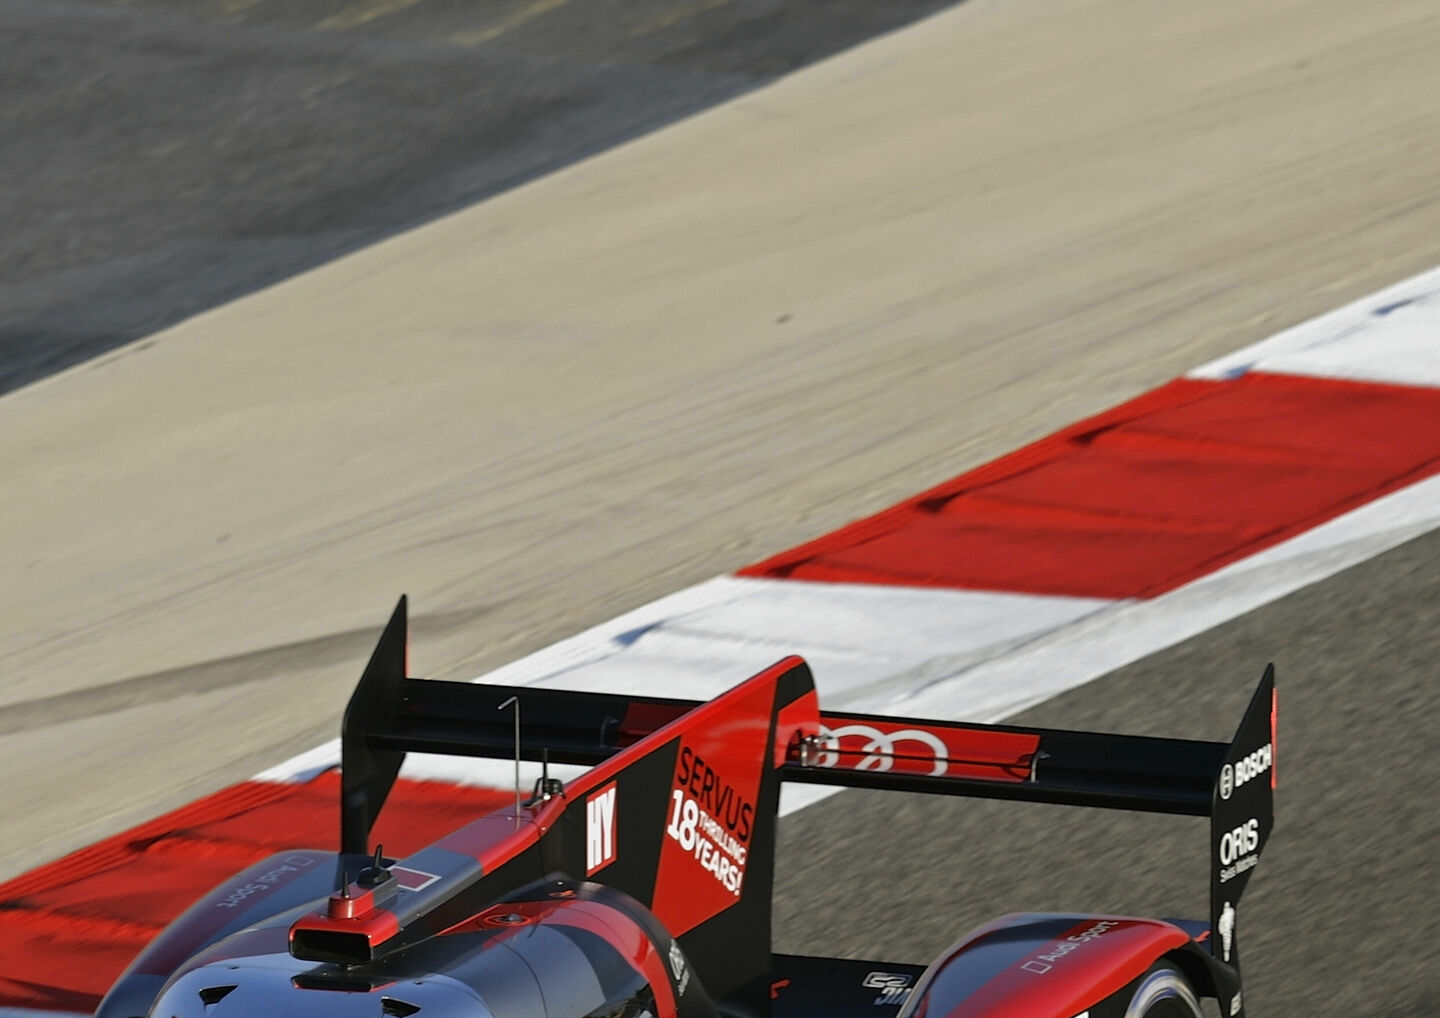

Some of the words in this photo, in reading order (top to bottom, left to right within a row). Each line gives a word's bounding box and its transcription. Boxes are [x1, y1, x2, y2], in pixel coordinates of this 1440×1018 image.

[677, 746, 753, 842] SERVUS
[1234, 743, 1271, 787] BOSCH
[587, 787, 616, 871] HY
[667, 789, 699, 851] 18
[698, 810, 747, 865] THRILLING
[1220, 818, 1259, 866] ORIS
[694, 833, 743, 896] YEARS!
[1037, 941, 1081, 962] Audi
[1066, 920, 1119, 942] Sport
